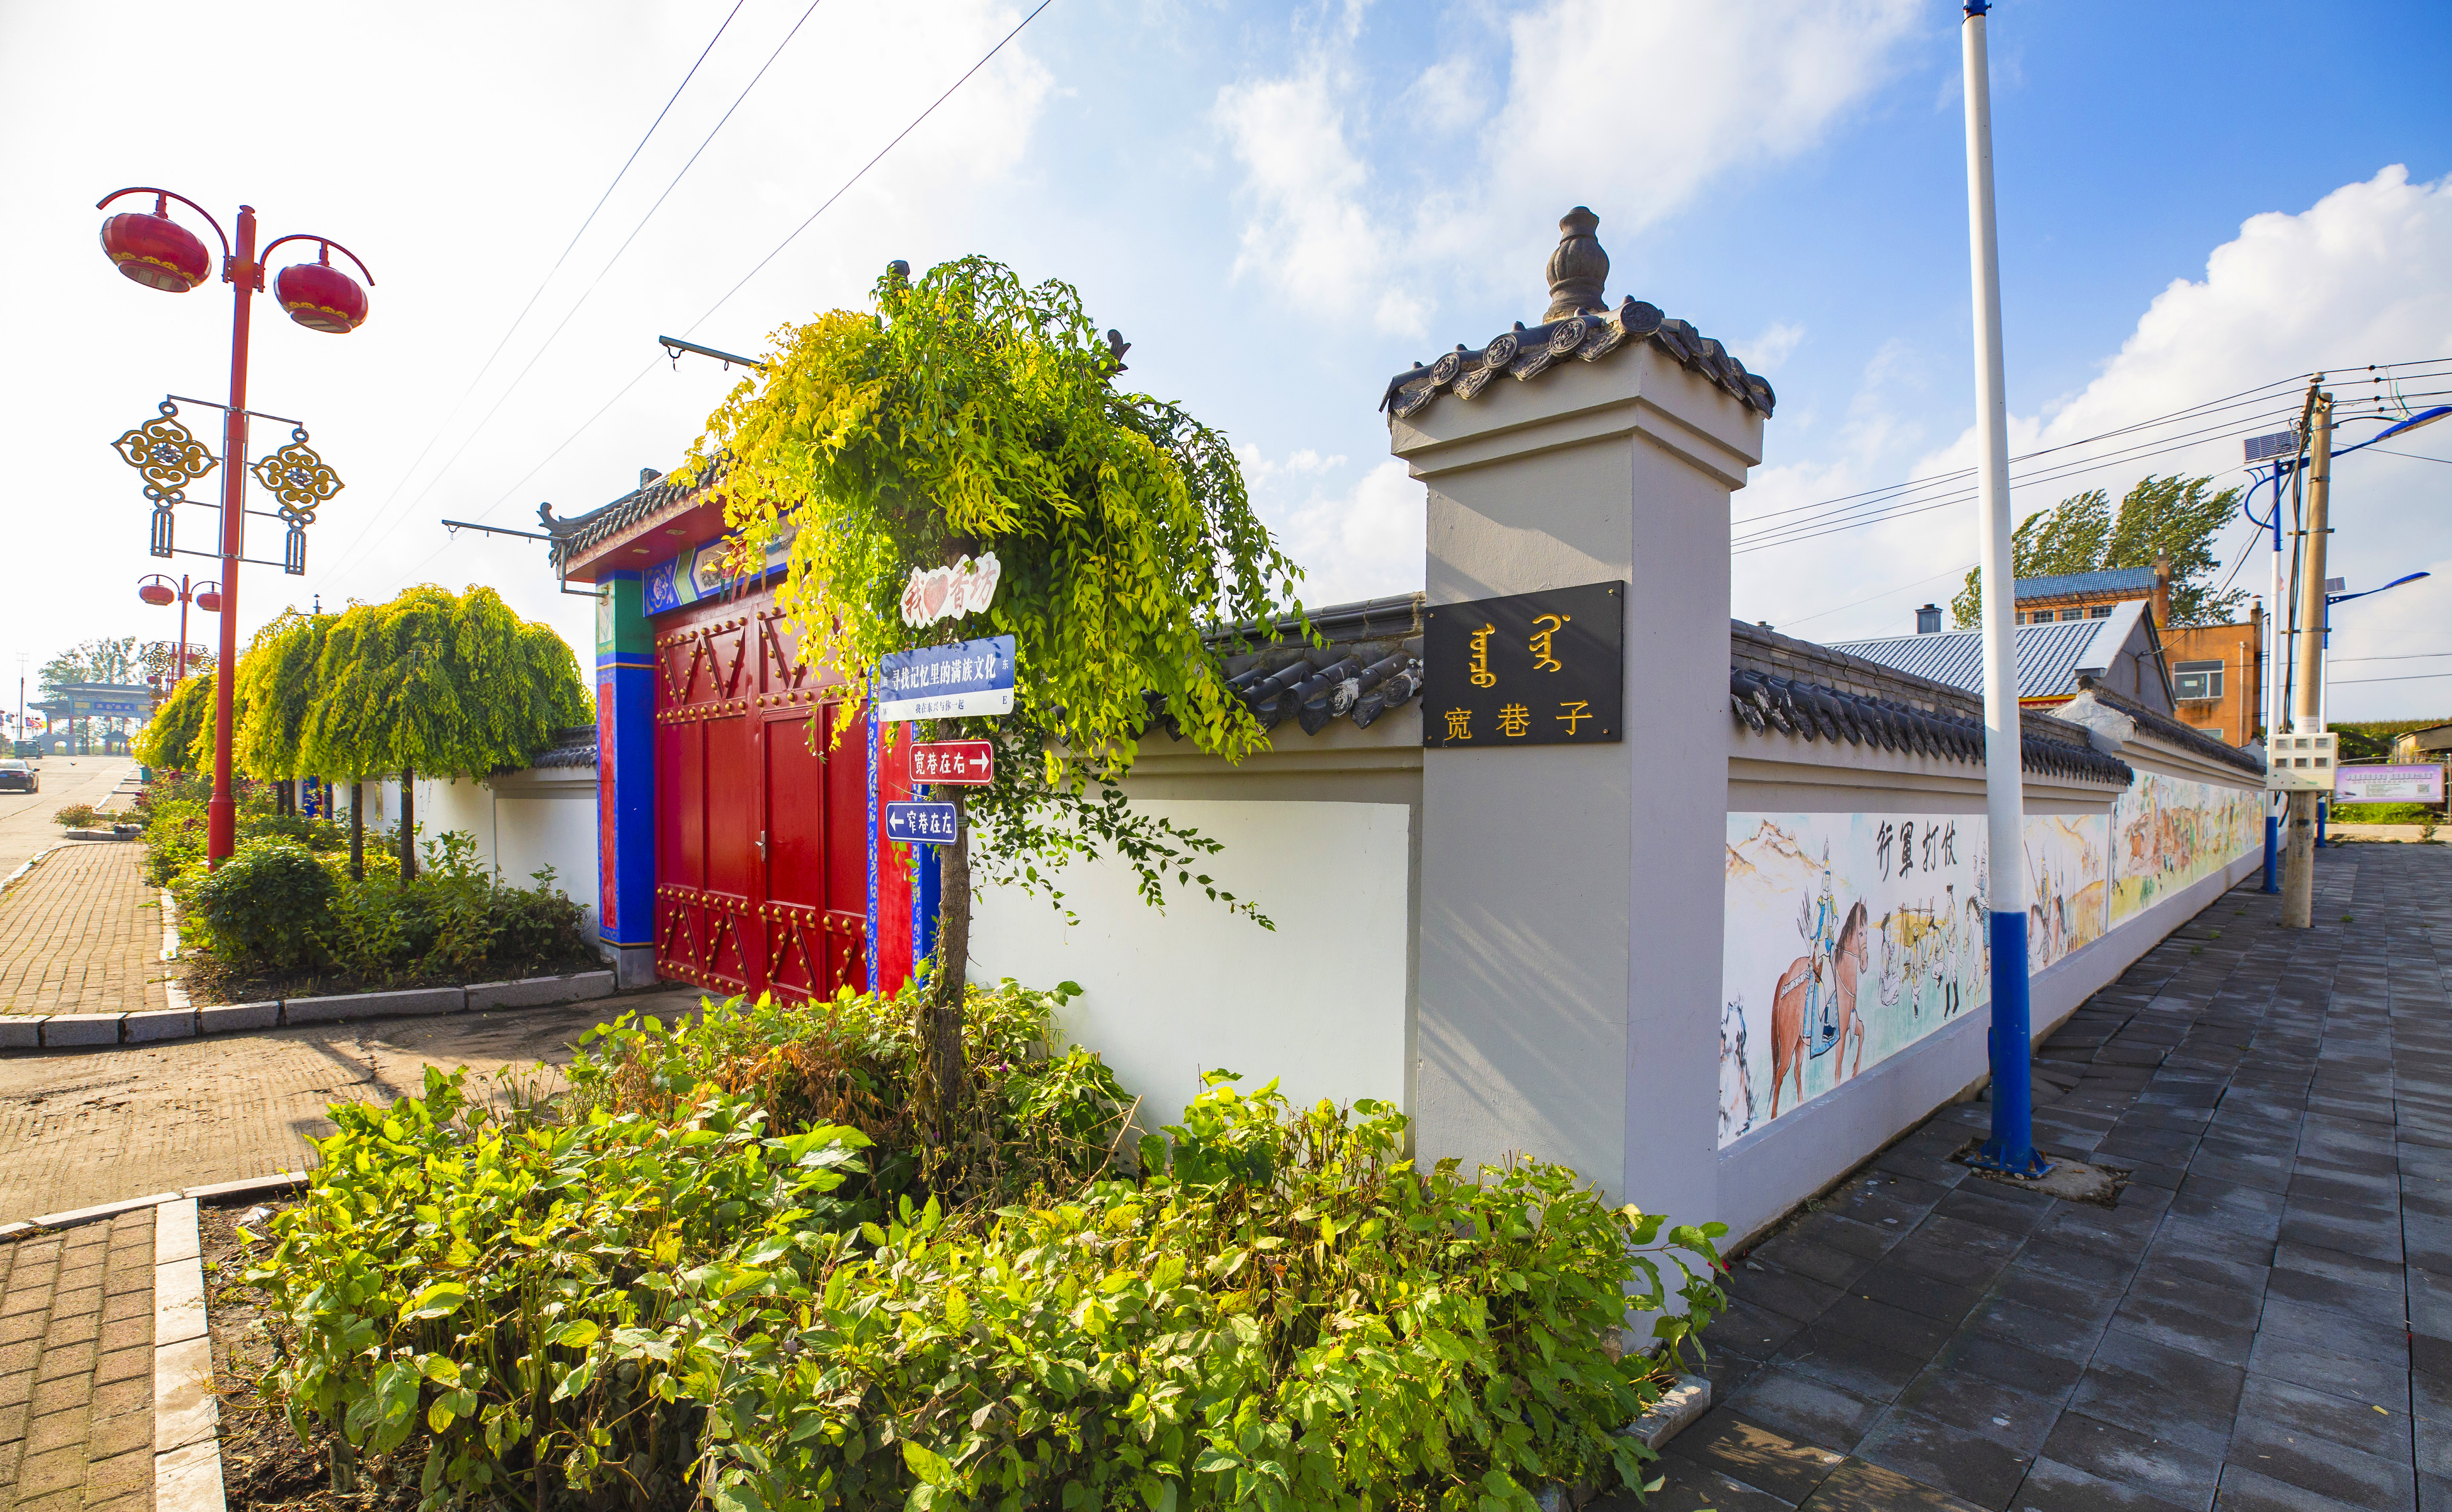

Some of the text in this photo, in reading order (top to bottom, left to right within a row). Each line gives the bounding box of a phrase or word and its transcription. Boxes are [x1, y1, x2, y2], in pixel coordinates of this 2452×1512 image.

[892, 653, 996, 691] 寻找记忆里的满族文化
[1002, 659, 1008, 670] 东
[883, 676, 888, 686] 西
[916, 699, 964, 714] 我在东兴与你一起
[1003, 696, 1007, 704] E
[1444, 700, 1593, 741] 宽巷子
[914, 750, 965, 775] 宽巷在右
[907, 810, 952, 834] 窄巷在左
